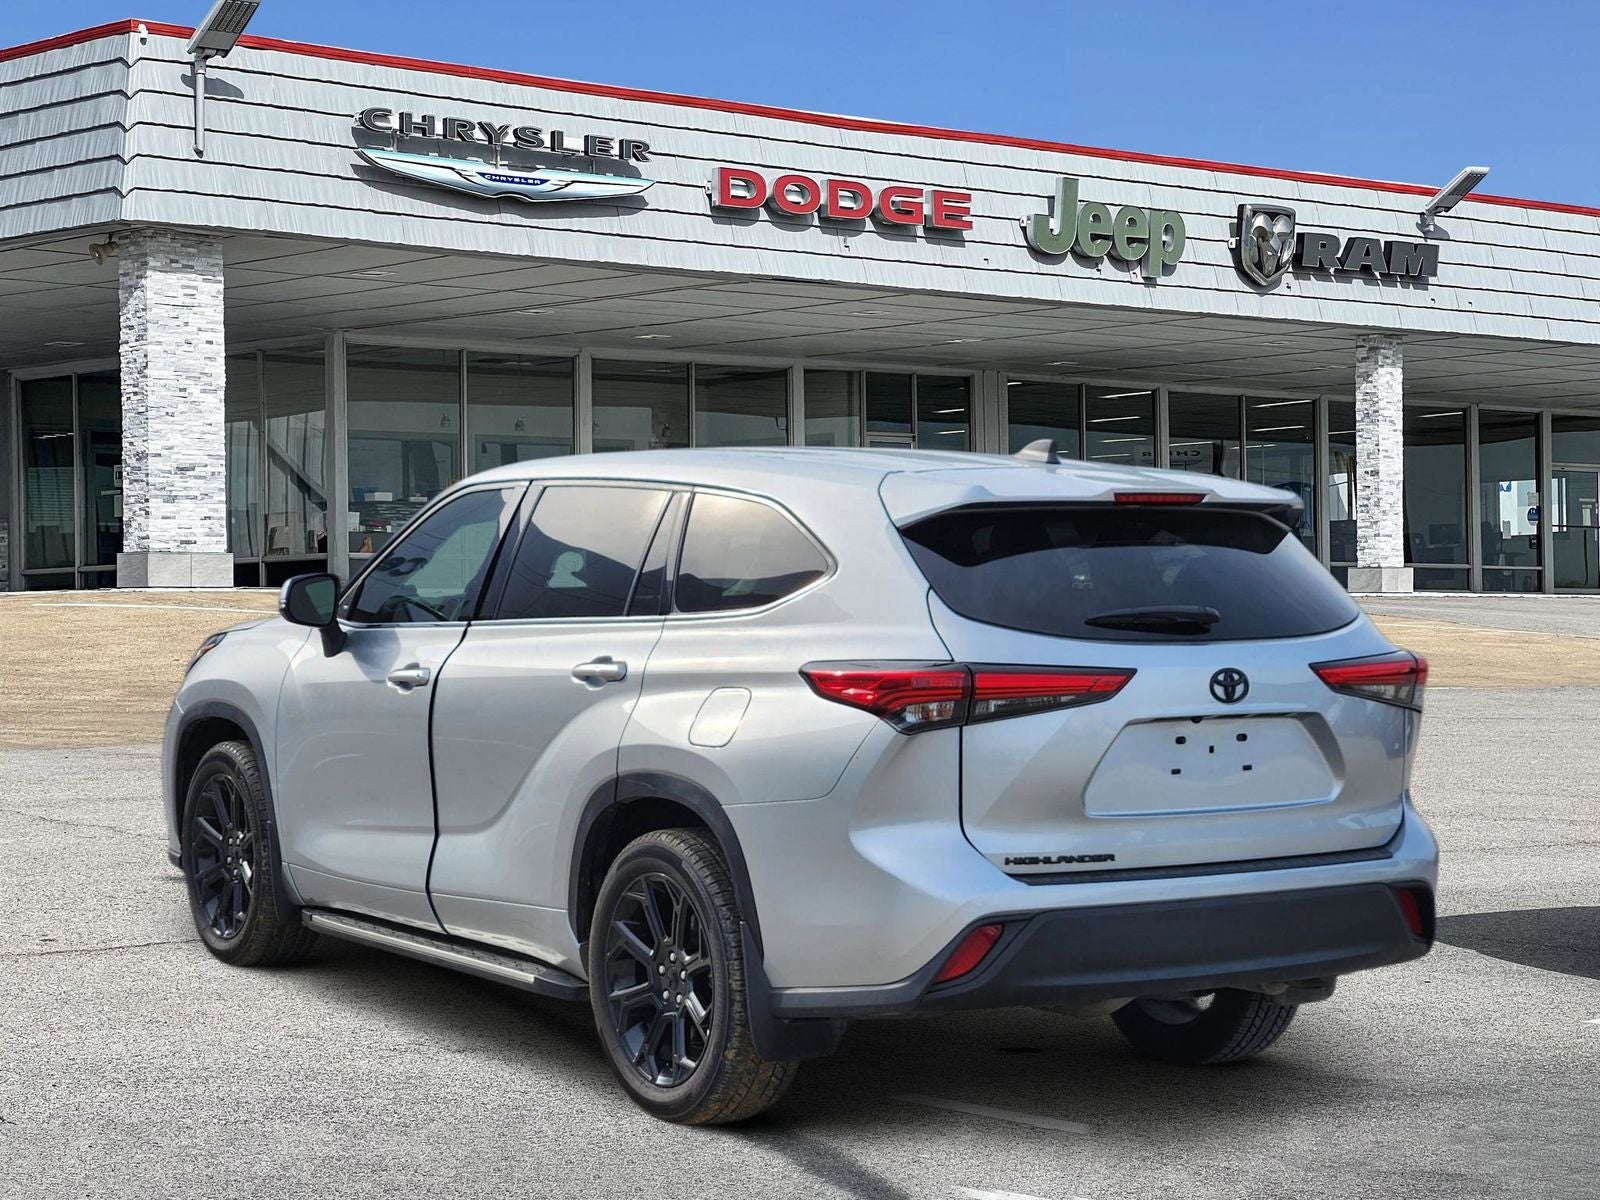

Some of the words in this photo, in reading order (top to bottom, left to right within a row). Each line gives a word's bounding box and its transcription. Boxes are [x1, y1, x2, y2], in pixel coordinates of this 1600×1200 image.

[359, 107, 651, 162] CHRYSLER
[484, 174, 541, 185] CHRYSLER
[713, 167, 973, 230] DODGE
[1027, 177, 1186, 278] Jeep
[1297, 232, 1440, 277] RAM
[1004, 853, 1116, 866] HIGHLANDER
